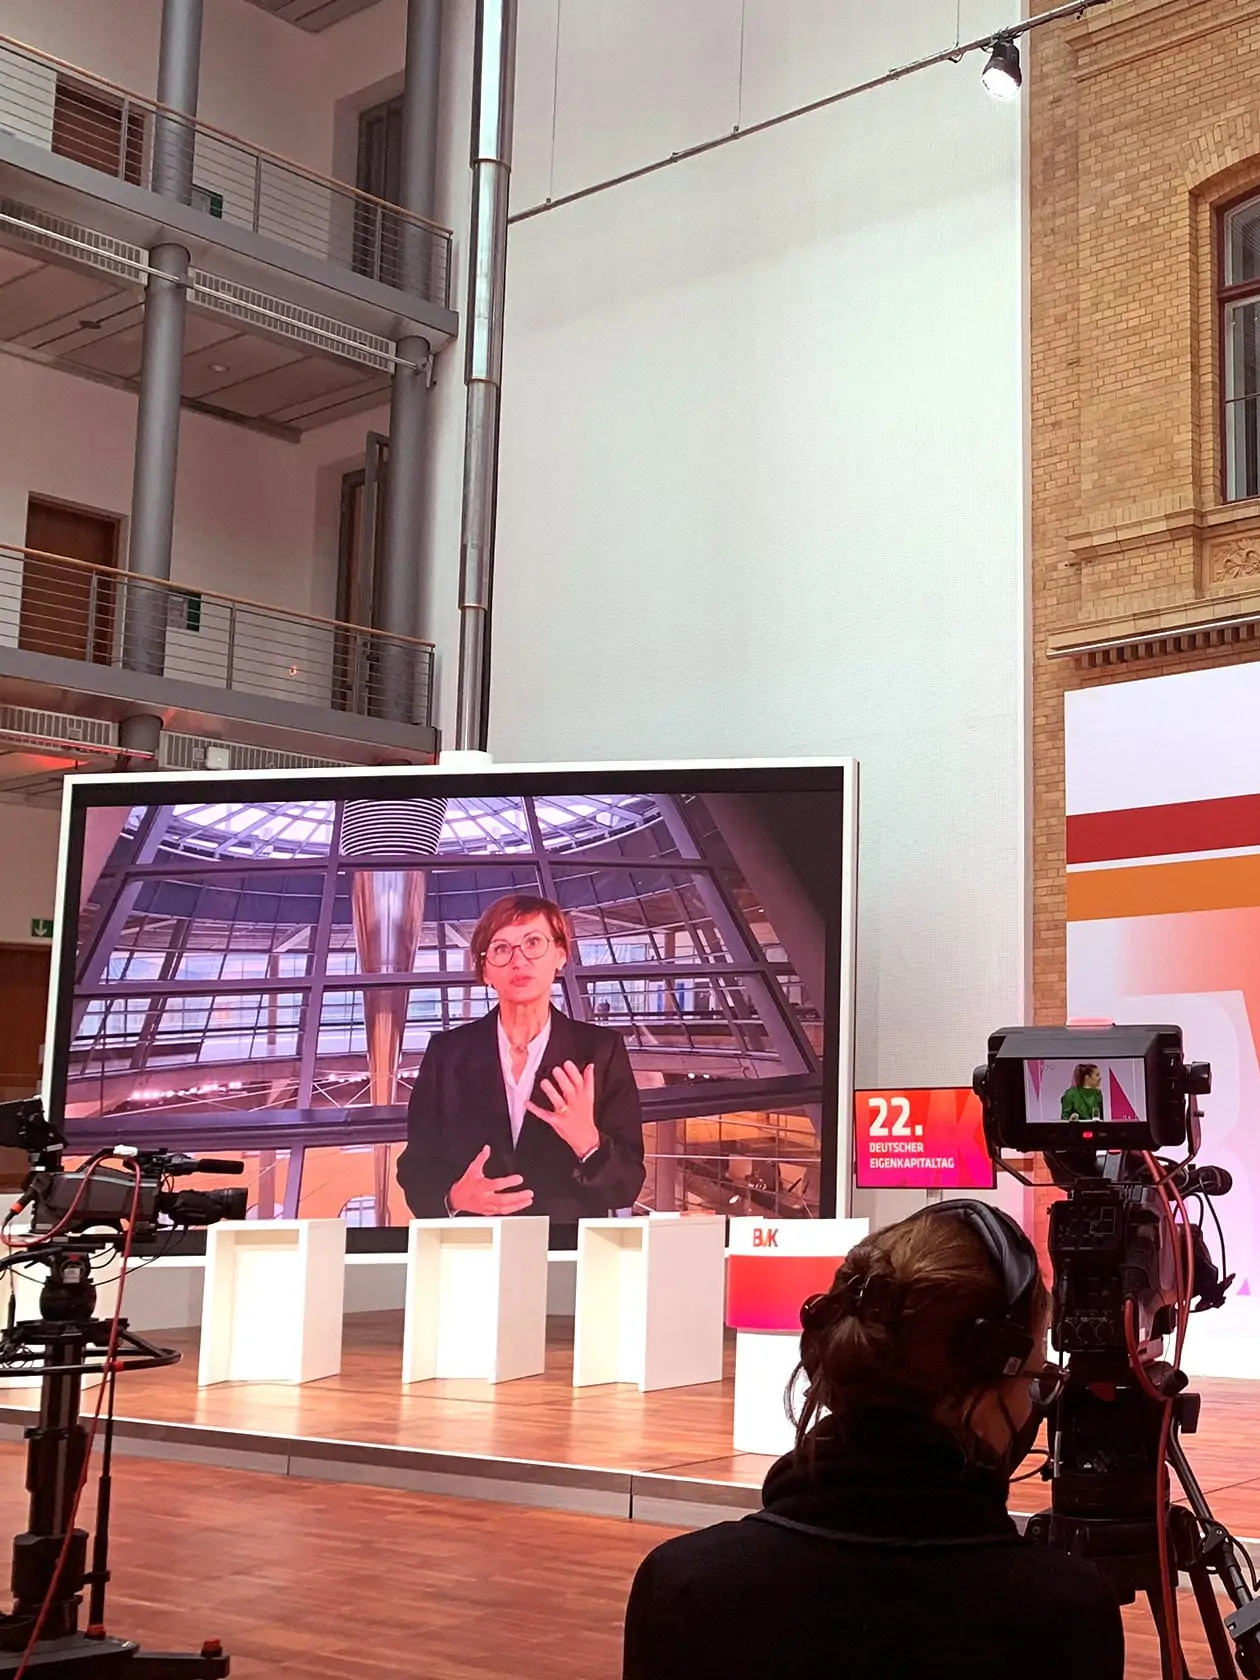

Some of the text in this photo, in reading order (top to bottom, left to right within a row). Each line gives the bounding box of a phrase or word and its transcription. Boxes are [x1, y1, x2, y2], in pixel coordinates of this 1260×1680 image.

[868, 1096, 923, 1136] 22.
[869, 1142, 924, 1153] DEUTSCHER
[869, 1157, 955, 1169] EIGENKAPITALTAG
[753, 1228, 779, 1248] BVK
